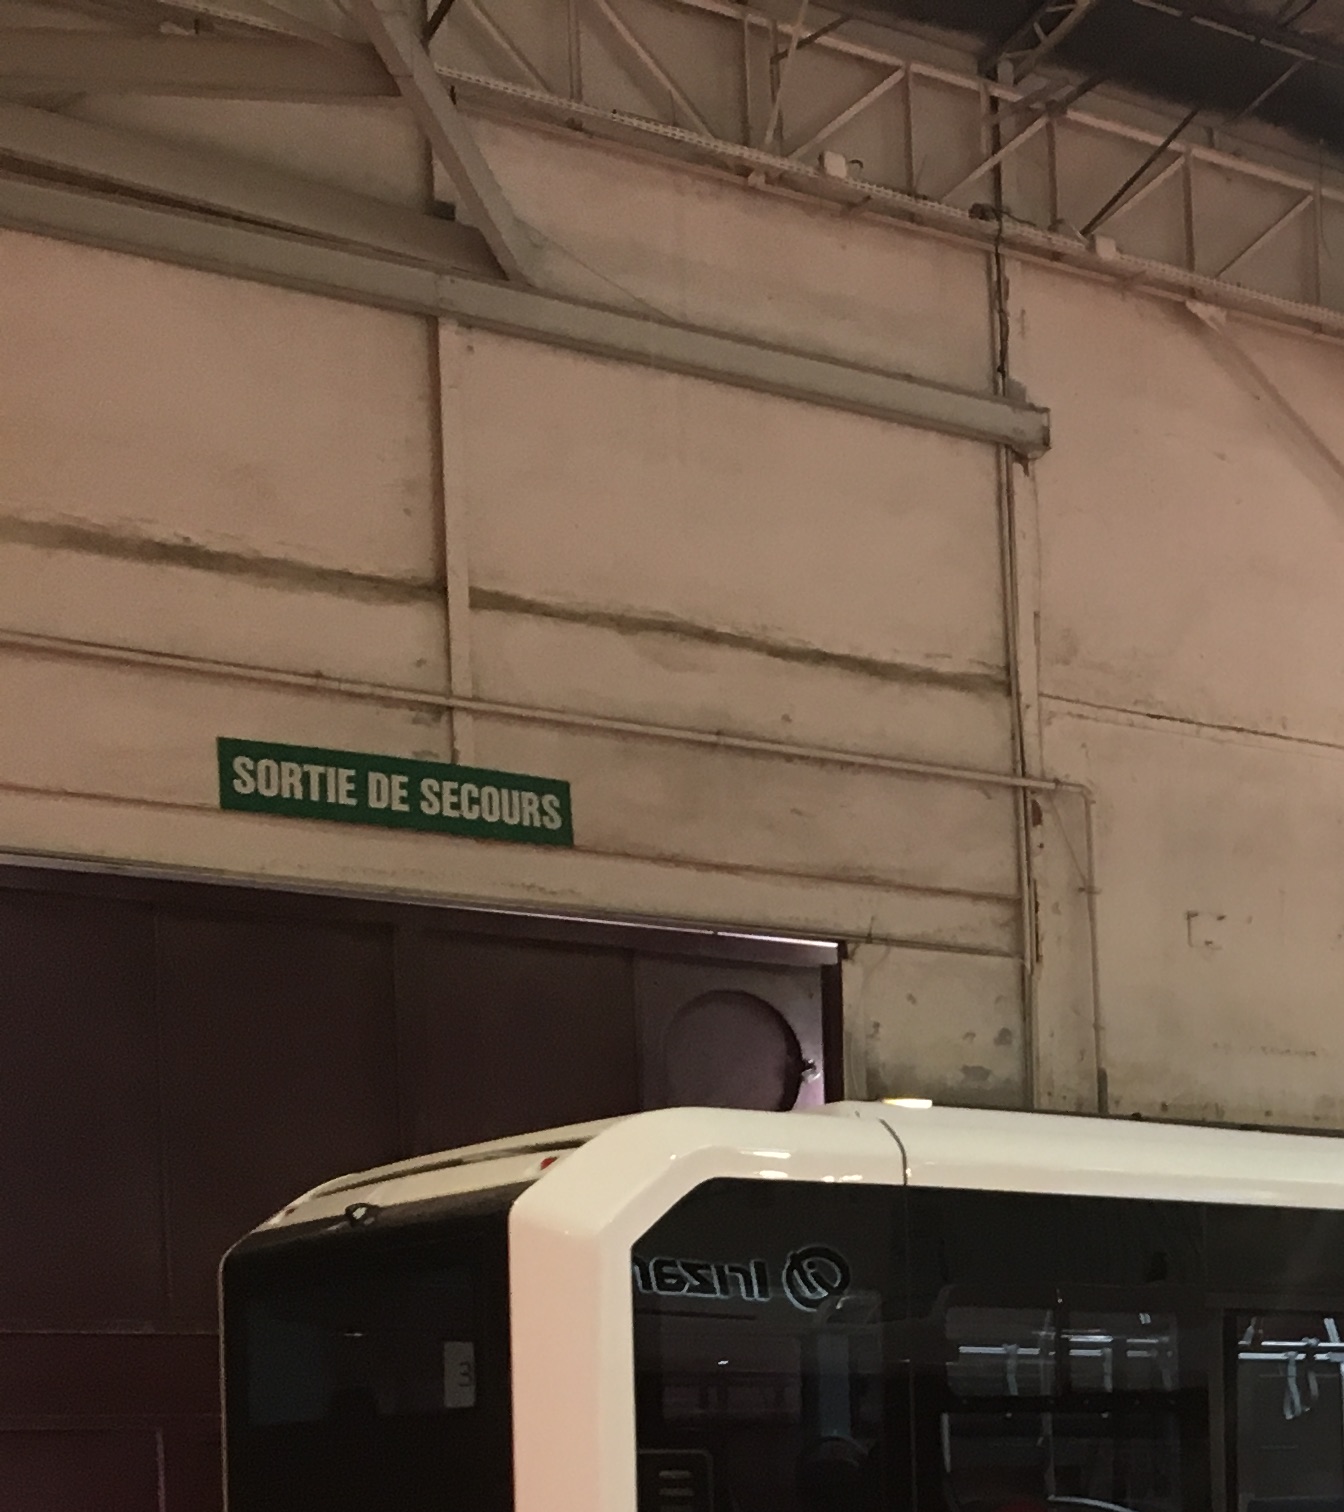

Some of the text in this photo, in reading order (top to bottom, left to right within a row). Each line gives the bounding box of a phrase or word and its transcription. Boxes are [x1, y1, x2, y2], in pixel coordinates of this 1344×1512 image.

[232, 755, 563, 831] SORTIE DE SECOURS
